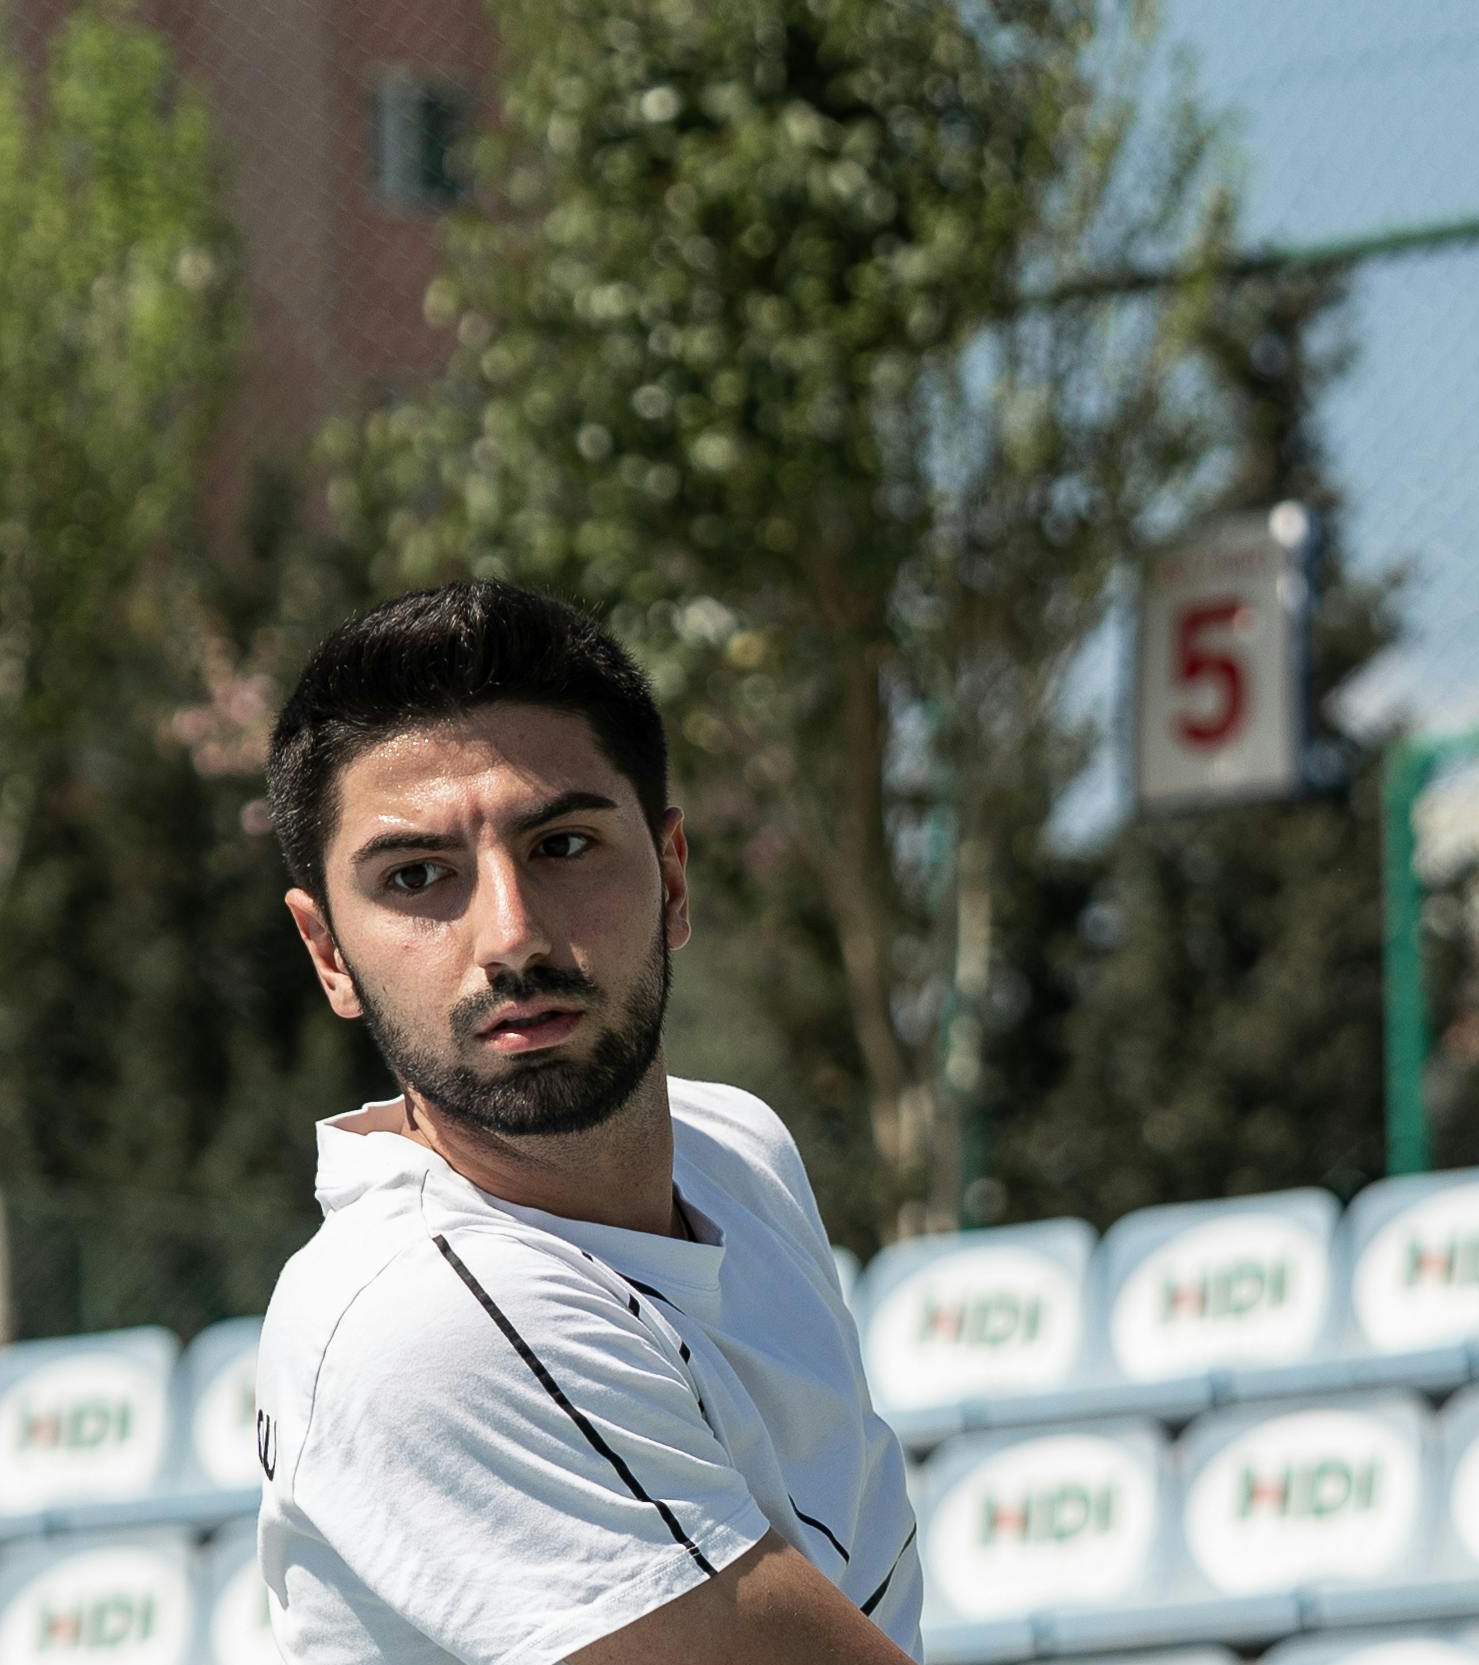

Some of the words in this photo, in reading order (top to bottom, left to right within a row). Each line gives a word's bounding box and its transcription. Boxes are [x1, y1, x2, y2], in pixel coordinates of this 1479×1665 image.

[1174, 596, 1249, 750] 5
[919, 1290, 1043, 1351] HDI
[1159, 1258, 1291, 1325] HDI
[16, 1395, 132, 1453] HDI
[979, 1481, 1115, 1550] HDI
[1237, 1455, 1378, 1520] HDI
[36, 1591, 154, 1653] HDI
